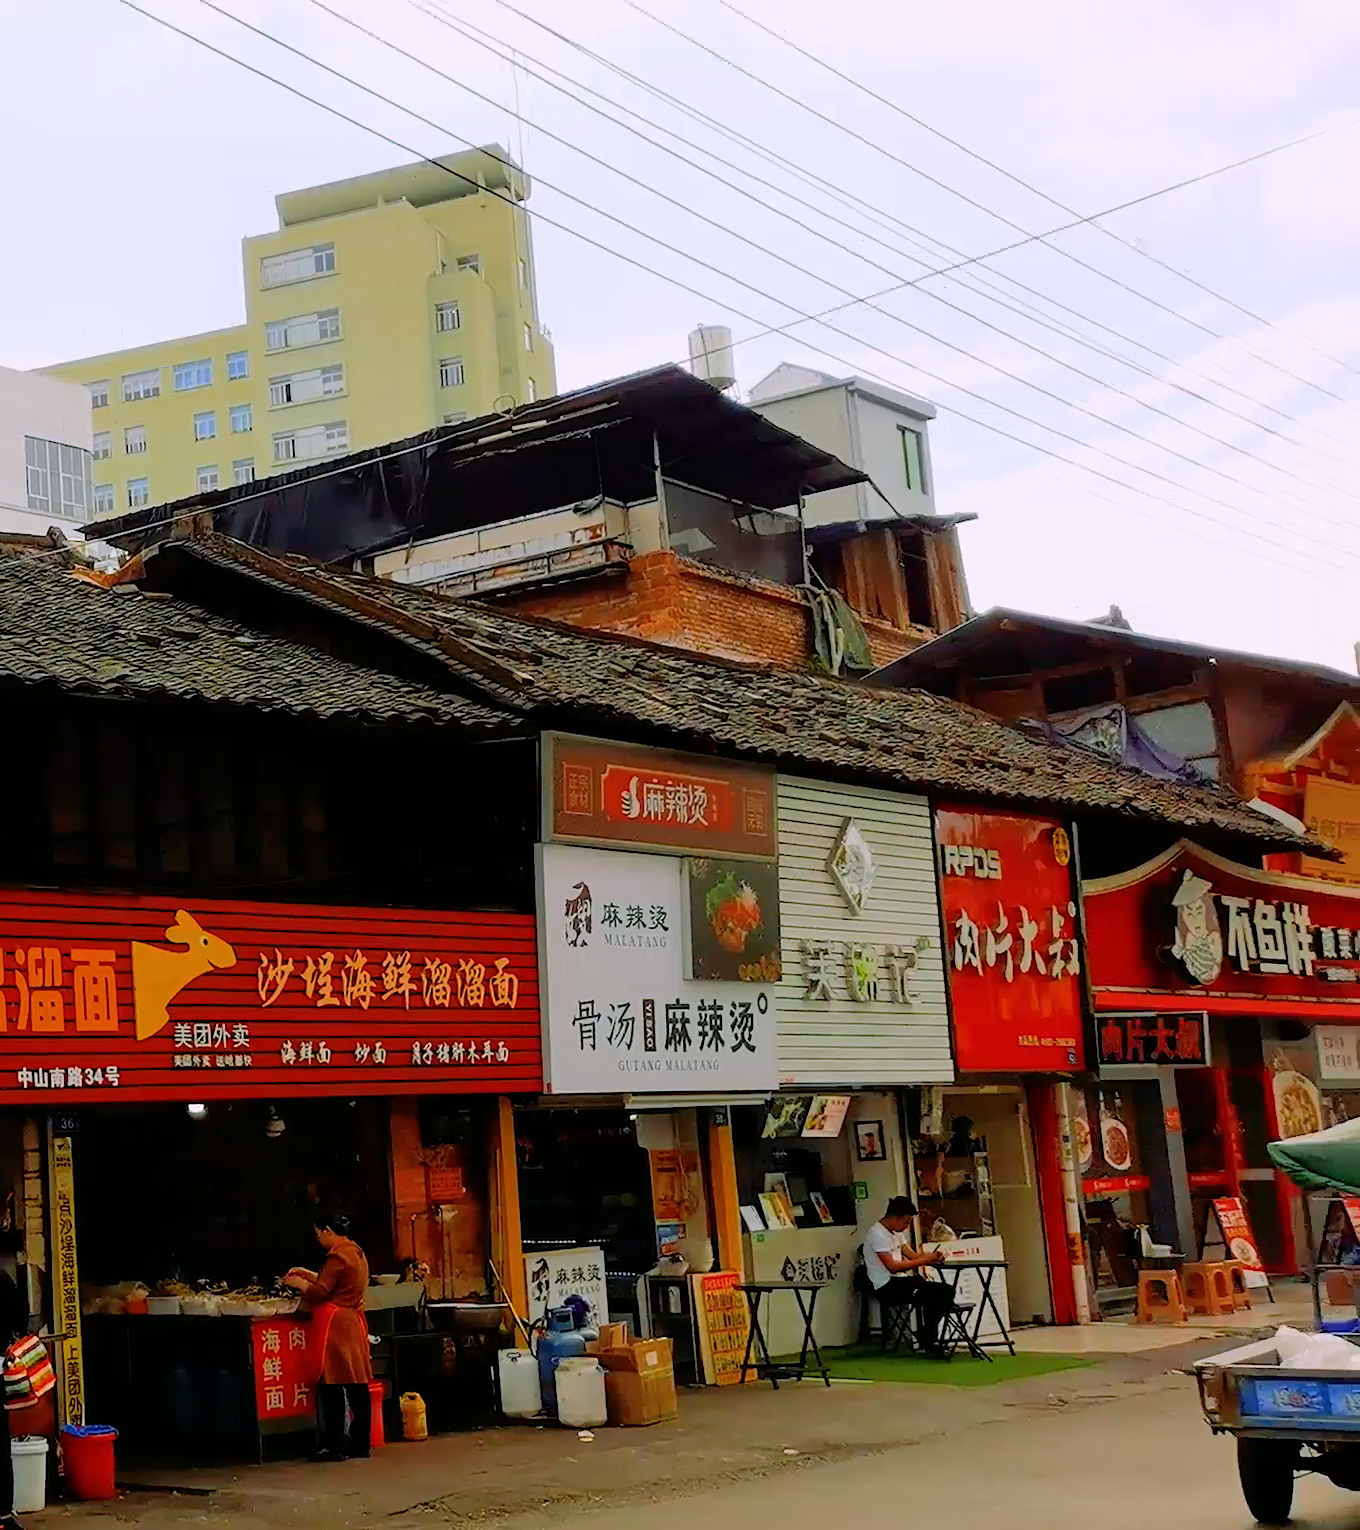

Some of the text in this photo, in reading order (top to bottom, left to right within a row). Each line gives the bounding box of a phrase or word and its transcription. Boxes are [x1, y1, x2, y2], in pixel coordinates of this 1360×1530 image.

[643, 779, 709, 826] 麻辣烫
[944, 845, 1002, 880] RPDS
[601, 902, 669, 931] 麻辣烫
[604, 933, 667, 948] MALATANG
[257, 948, 520, 1011] 沙埕海鲜溜溜面
[174, 1023, 250, 1048] 美团外卖
[572, 1000, 636, 1051] 骨汤
[664, 998, 757, 1054] 麻辣烫
[280, 1040, 332, 1065] 海鲜面
[354, 1041, 387, 1064] 炒面
[618, 1060, 719, 1072] GUTANG MALATANG
[17, 1067, 120, 1088] 中山南路34号
[555, 1264, 601, 1284] 麻辣烫
[261, 1328, 285, 1411] 海鲜面
[288, 1327, 310, 1407] 肉片
